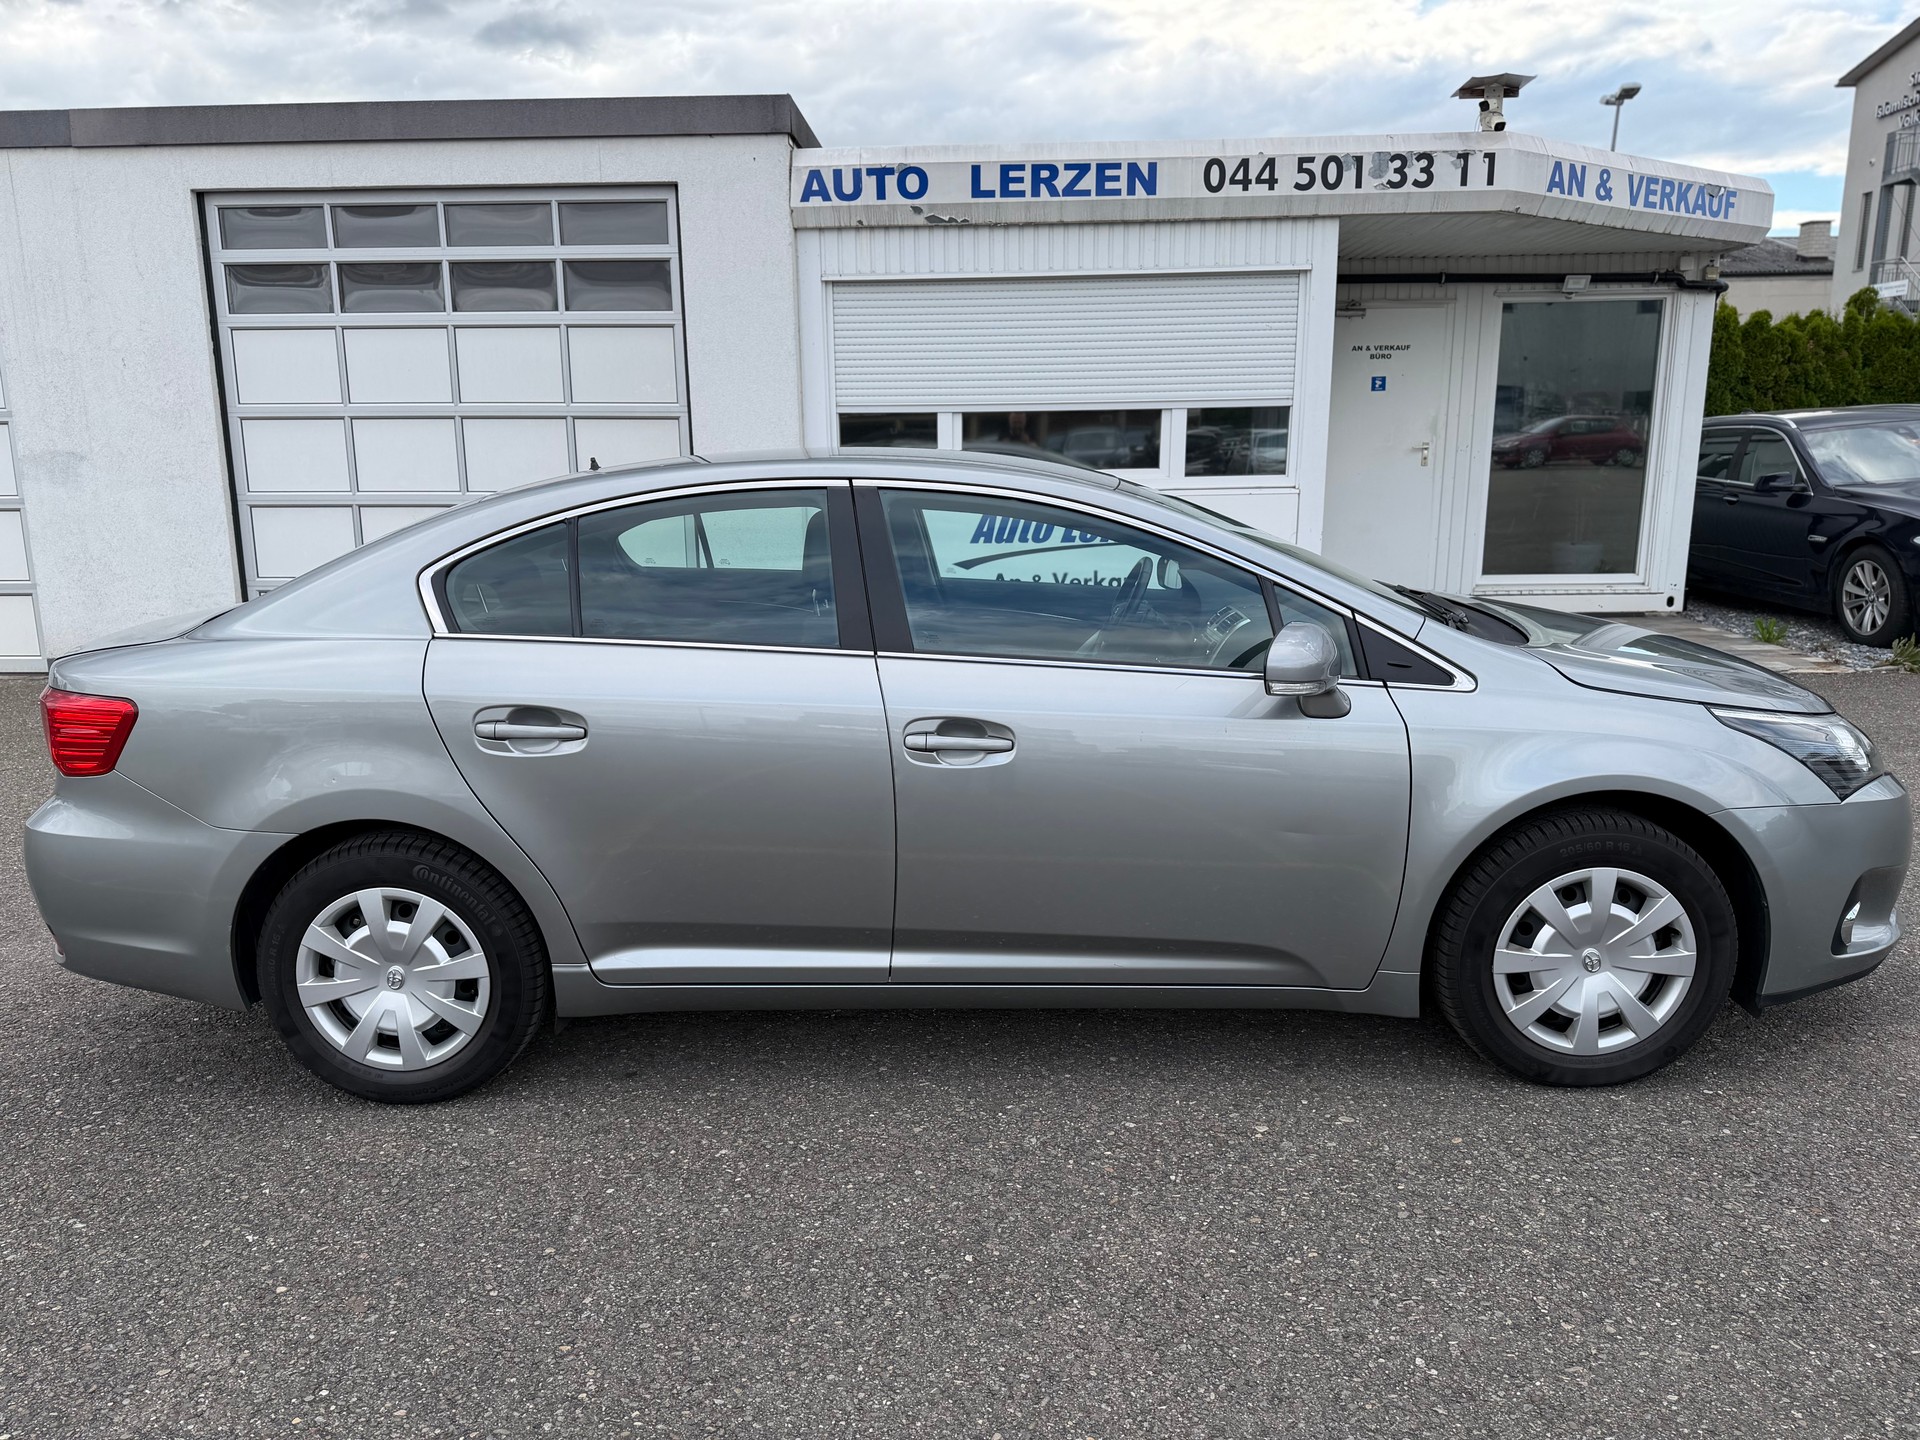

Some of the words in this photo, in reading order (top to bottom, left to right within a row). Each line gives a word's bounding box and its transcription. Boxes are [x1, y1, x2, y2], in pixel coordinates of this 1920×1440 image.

[800, 165, 928, 203] AUTO
[970, 161, 1158, 199] LERZEN
[1203, 157, 1279, 194] 044
[1293, 154, 1363, 191] 501
[1386, 152, 1435, 189] 33
[1457, 151, 1496, 187] 11
[1546, 160, 1587, 198] AN
[1595, 168, 1613, 202] &
[1627, 173, 1738, 220] VERKAUF
[412, 864, 496, 925] Continental
